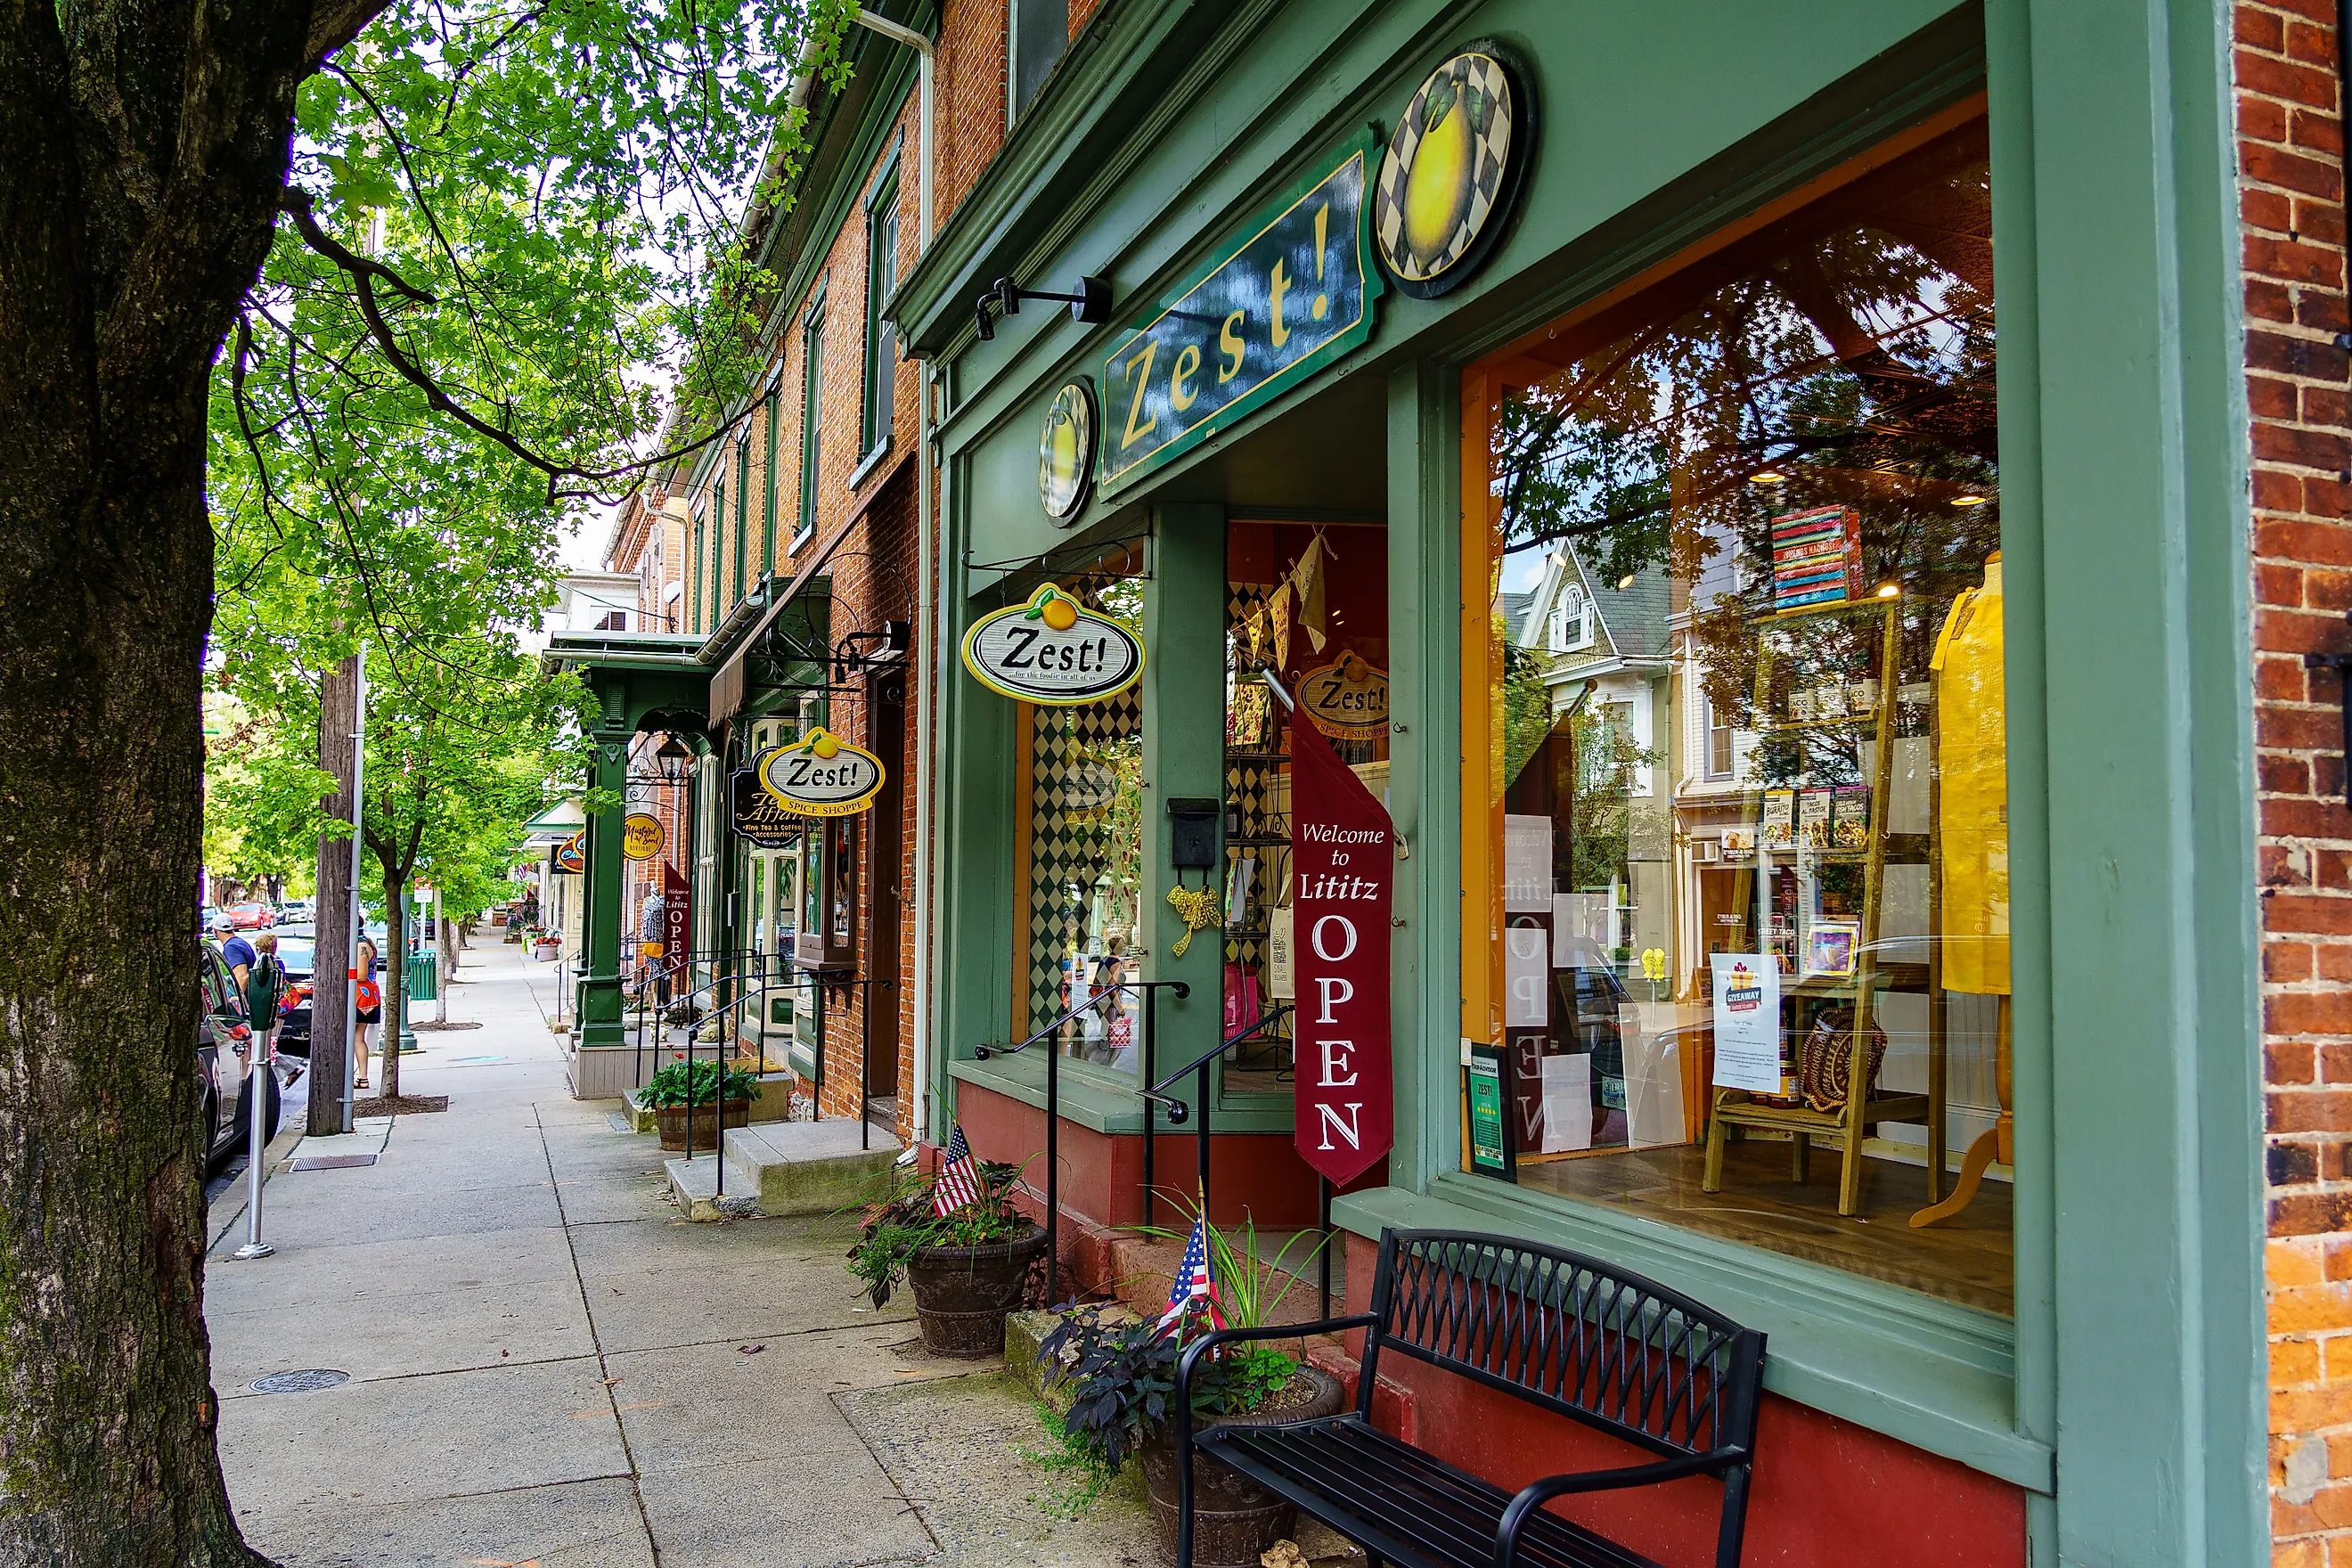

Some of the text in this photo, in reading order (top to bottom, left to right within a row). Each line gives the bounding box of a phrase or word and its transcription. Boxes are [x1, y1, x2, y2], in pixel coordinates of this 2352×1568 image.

[1121, 200, 1329, 450] Zest!
[1000, 626, 1107, 673] Zest!
[1040, 672, 1058, 680] foodie
[1319, 681, 1385, 711] Zest!
[1319, 723, 1348, 738] SPICE
[787, 758, 858, 787] Zest!
[788, 800, 864, 815] SPICE SHOPPE
[1847, 803, 1864, 813] TACOS
[625, 824, 657, 843] Mustard
[1303, 823, 1384, 845] Welcome
[629, 845, 651, 853] BOUTIQUE
[1332, 849, 1350, 866] to
[1301, 873, 1378, 901] Lititz
[666, 901, 688, 909] Lititz
[669, 911, 683, 968] OPEN
[1727, 990, 1760, 1002] GIVEAWAY
[1311, 914, 1363, 1151] OPEN
[1477, 1082, 1493, 1097] ZEST!
